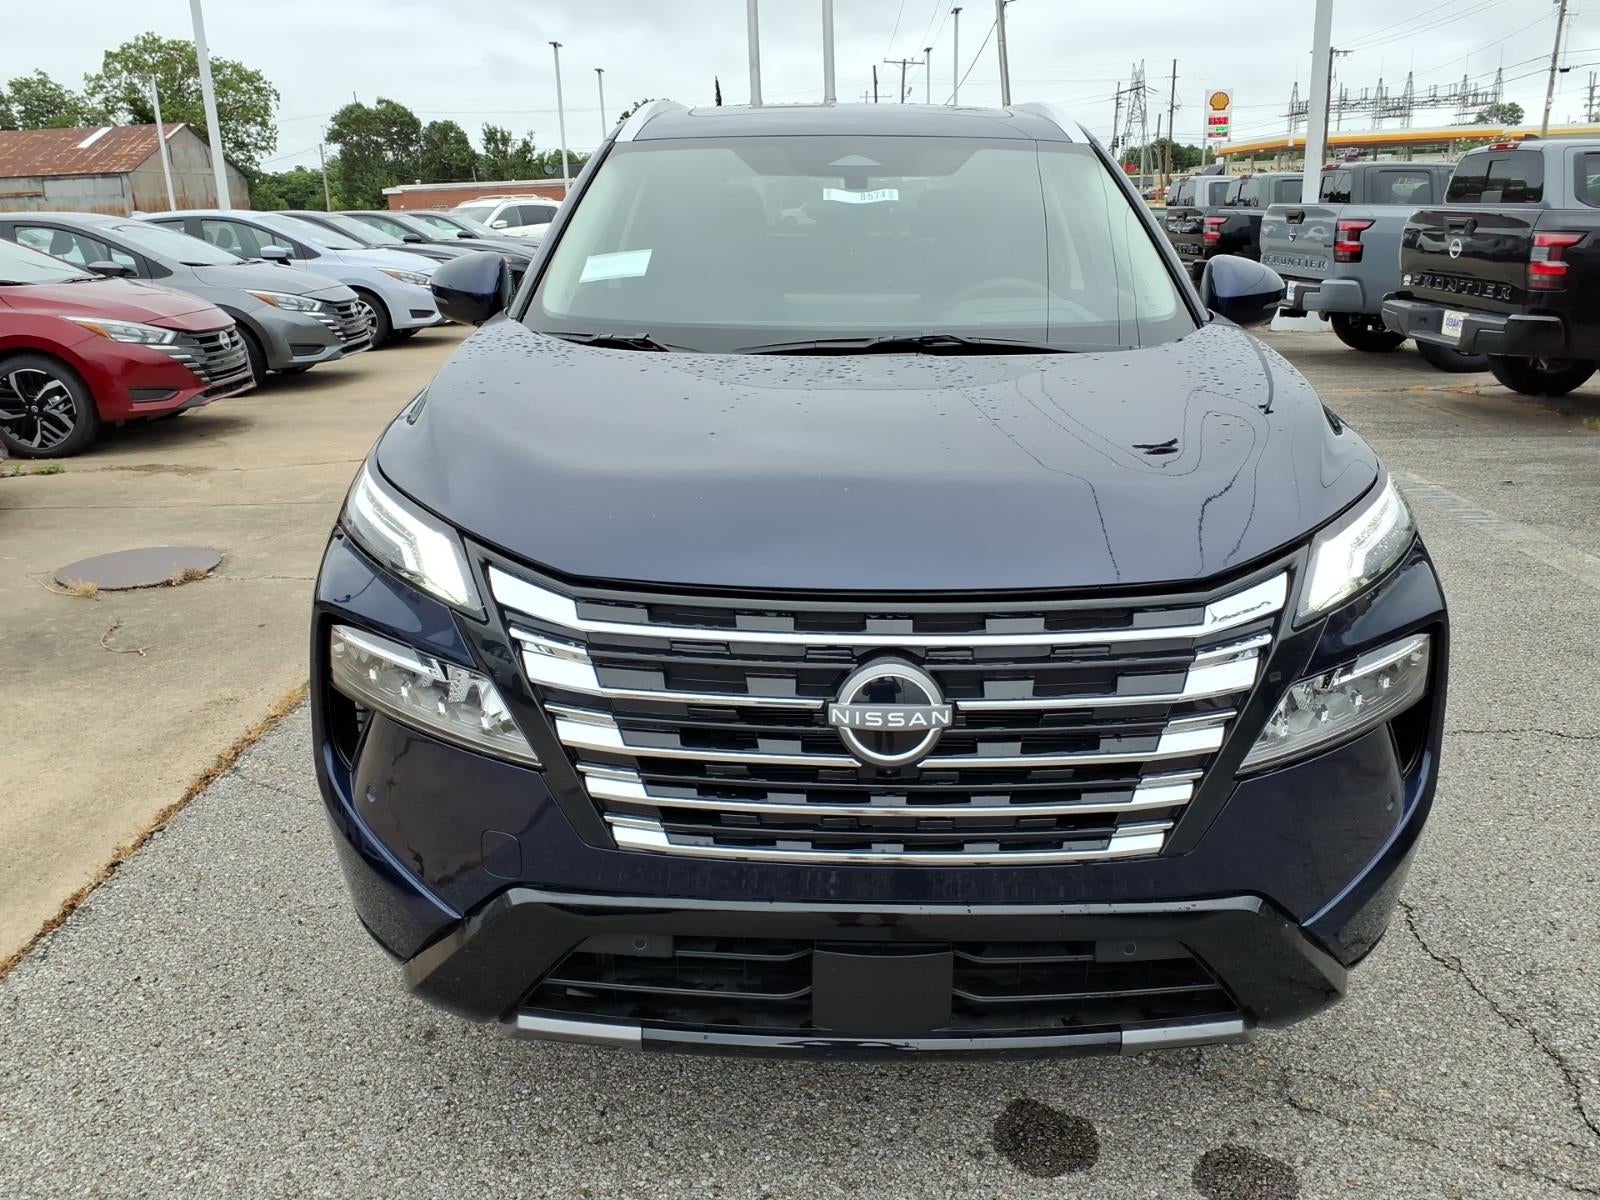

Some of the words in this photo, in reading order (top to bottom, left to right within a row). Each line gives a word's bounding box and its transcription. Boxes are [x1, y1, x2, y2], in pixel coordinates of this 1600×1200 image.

[1266, 255, 1328, 271] FRONTIER
[1411, 271, 1511, 300] FRONTIER
[831, 708, 950, 727] NISSAN
